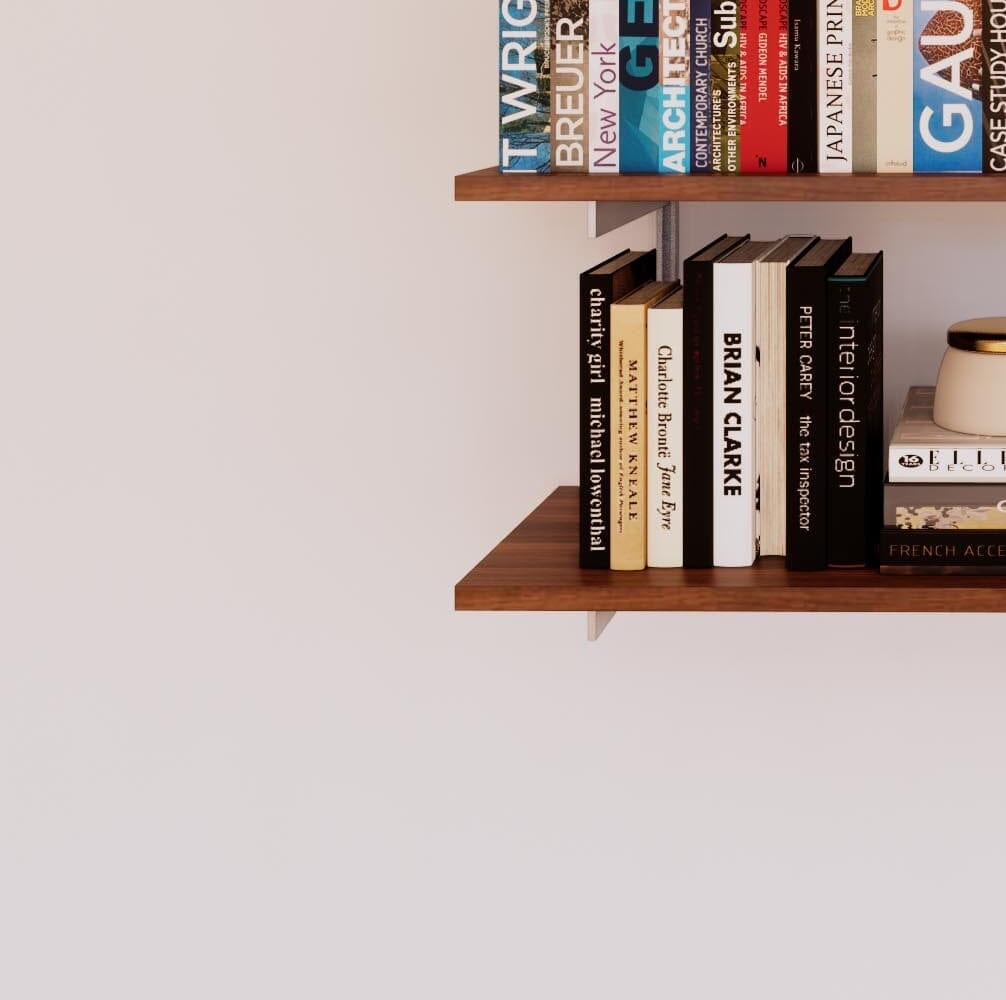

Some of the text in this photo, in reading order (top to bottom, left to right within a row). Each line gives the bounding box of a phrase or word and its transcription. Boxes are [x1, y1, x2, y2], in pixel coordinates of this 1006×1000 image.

[556, 17, 584, 167] BREUER
[591, 42, 617, 167] New York
[695, 17, 708, 169] CONTEMPORARY CHURCH
[758, 33, 768, 66] GIDEON
[758, 68, 768, 102] MENDEL
[778, 60, 788, 81] AIDS
[712, 89, 722, 172] ARCHITECTURE'S
[728, 61, 737, 172] OTHER ENVIRONMENTS
[778, 95, 788, 126] AFRICA
[826, 53, 848, 162] JAPANESE
[587, 288, 606, 551] charity girl michael lowenthal
[628, 360, 638, 521] MATTHEW KNEALE
[657, 345, 676, 531] Charlotte Brontë Jane Eyre
[723, 333, 742, 496] BRIAN CLARKE
[797, 306, 813, 532] PETER CAREY the tax inspector
[902, 455, 920, 463] 16
[889, 544, 956, 558] FRENCH
